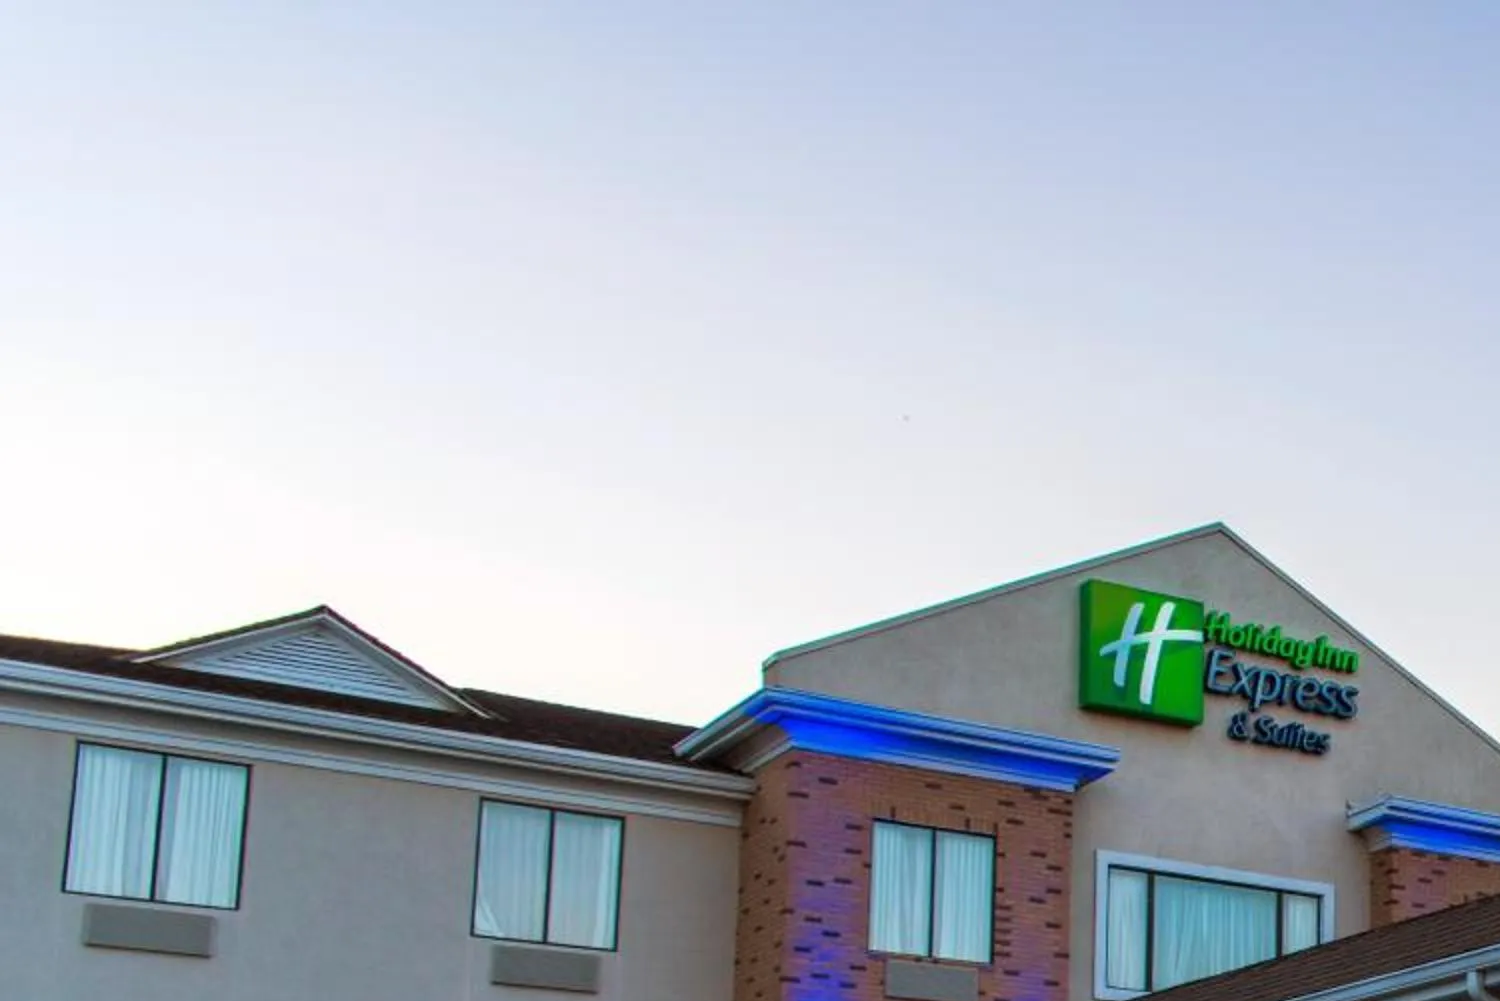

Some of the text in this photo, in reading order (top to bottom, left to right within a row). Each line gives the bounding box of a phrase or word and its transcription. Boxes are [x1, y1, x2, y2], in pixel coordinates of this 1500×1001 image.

[1206, 611, 1359, 673] Holiday Inn
[1205, 649, 1359, 719] Express
[1228, 711, 1331, 754] & Suites
